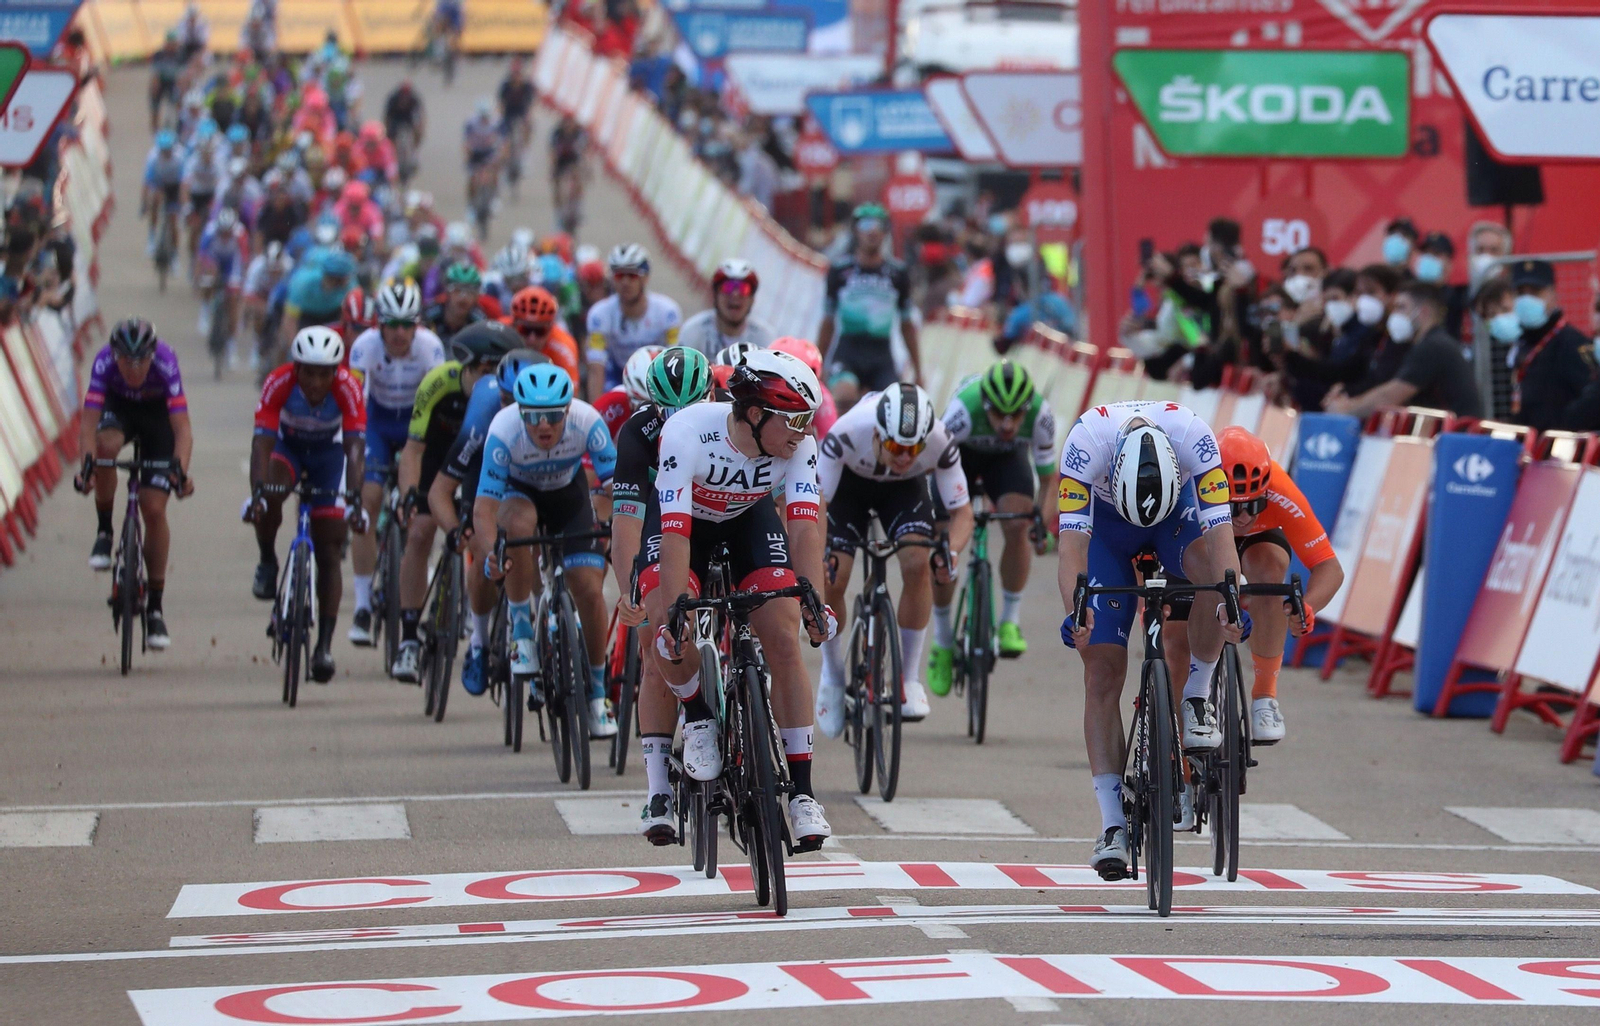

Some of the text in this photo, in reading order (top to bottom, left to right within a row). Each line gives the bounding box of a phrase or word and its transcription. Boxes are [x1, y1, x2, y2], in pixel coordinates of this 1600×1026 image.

[1159, 75, 1393, 125] ŠKODA
[1262, 218, 1310, 256] 50
[642, 417, 660, 437] BOR
[699, 431, 721, 444] UAE
[705, 460, 773, 490] UAE
[1263, 489, 1306, 519] GIANT
[767, 532, 788, 564] UAE
[238, 862, 1524, 912] COFIDIS
